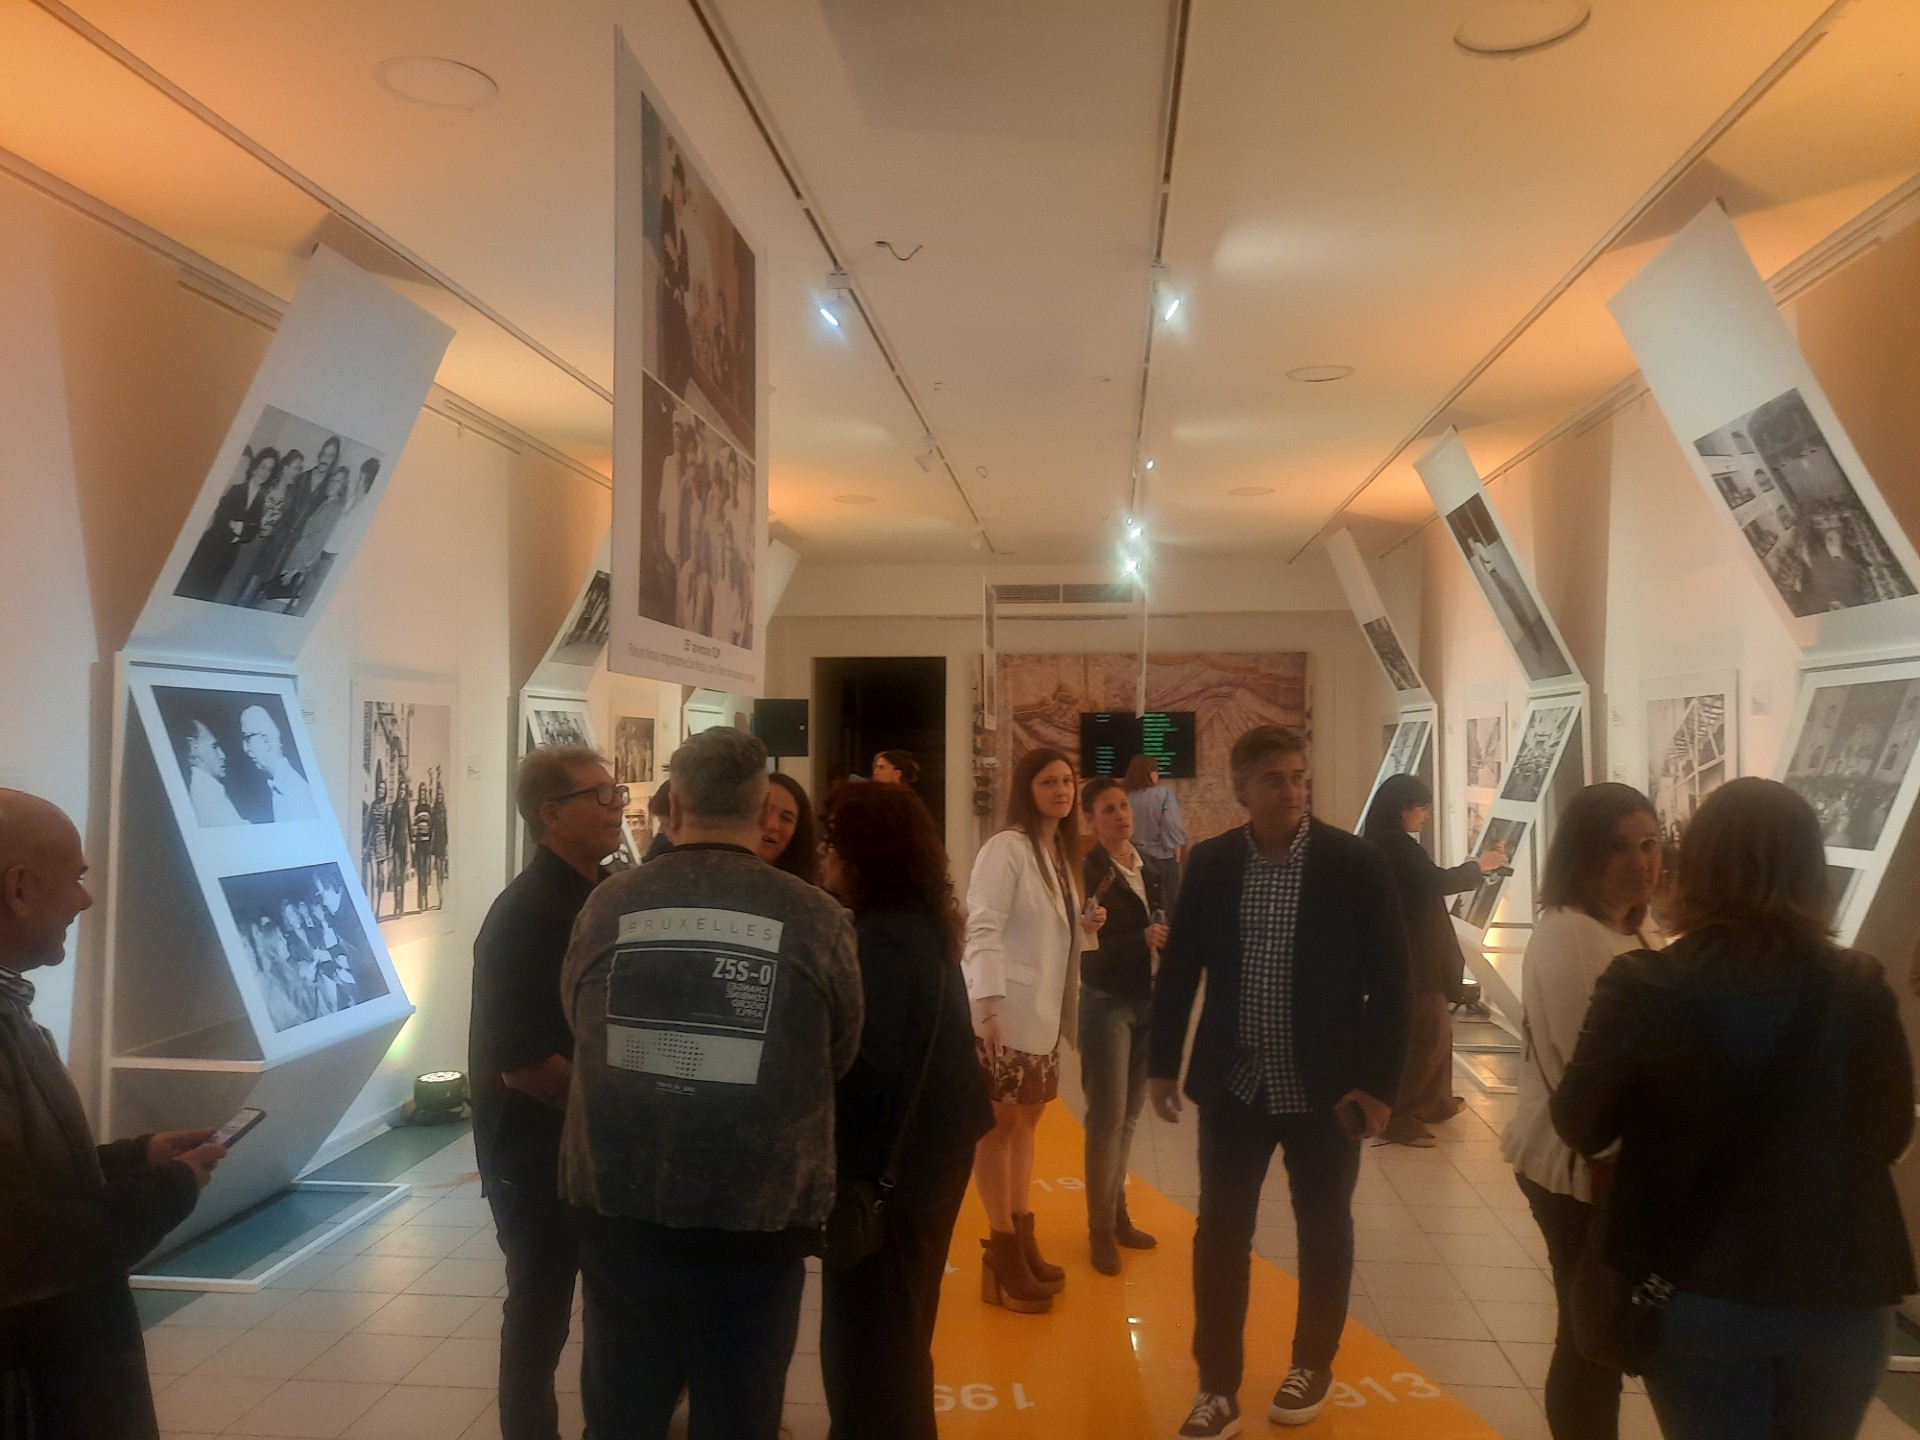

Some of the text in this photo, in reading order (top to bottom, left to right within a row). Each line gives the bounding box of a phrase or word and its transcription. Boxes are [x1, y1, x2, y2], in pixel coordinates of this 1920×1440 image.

[628, 918, 773, 941] BRUXELLES
[1032, 1176, 1087, 1193] 19
[933, 1382, 1036, 1412] 199
[1331, 1372, 1442, 1408] 913
